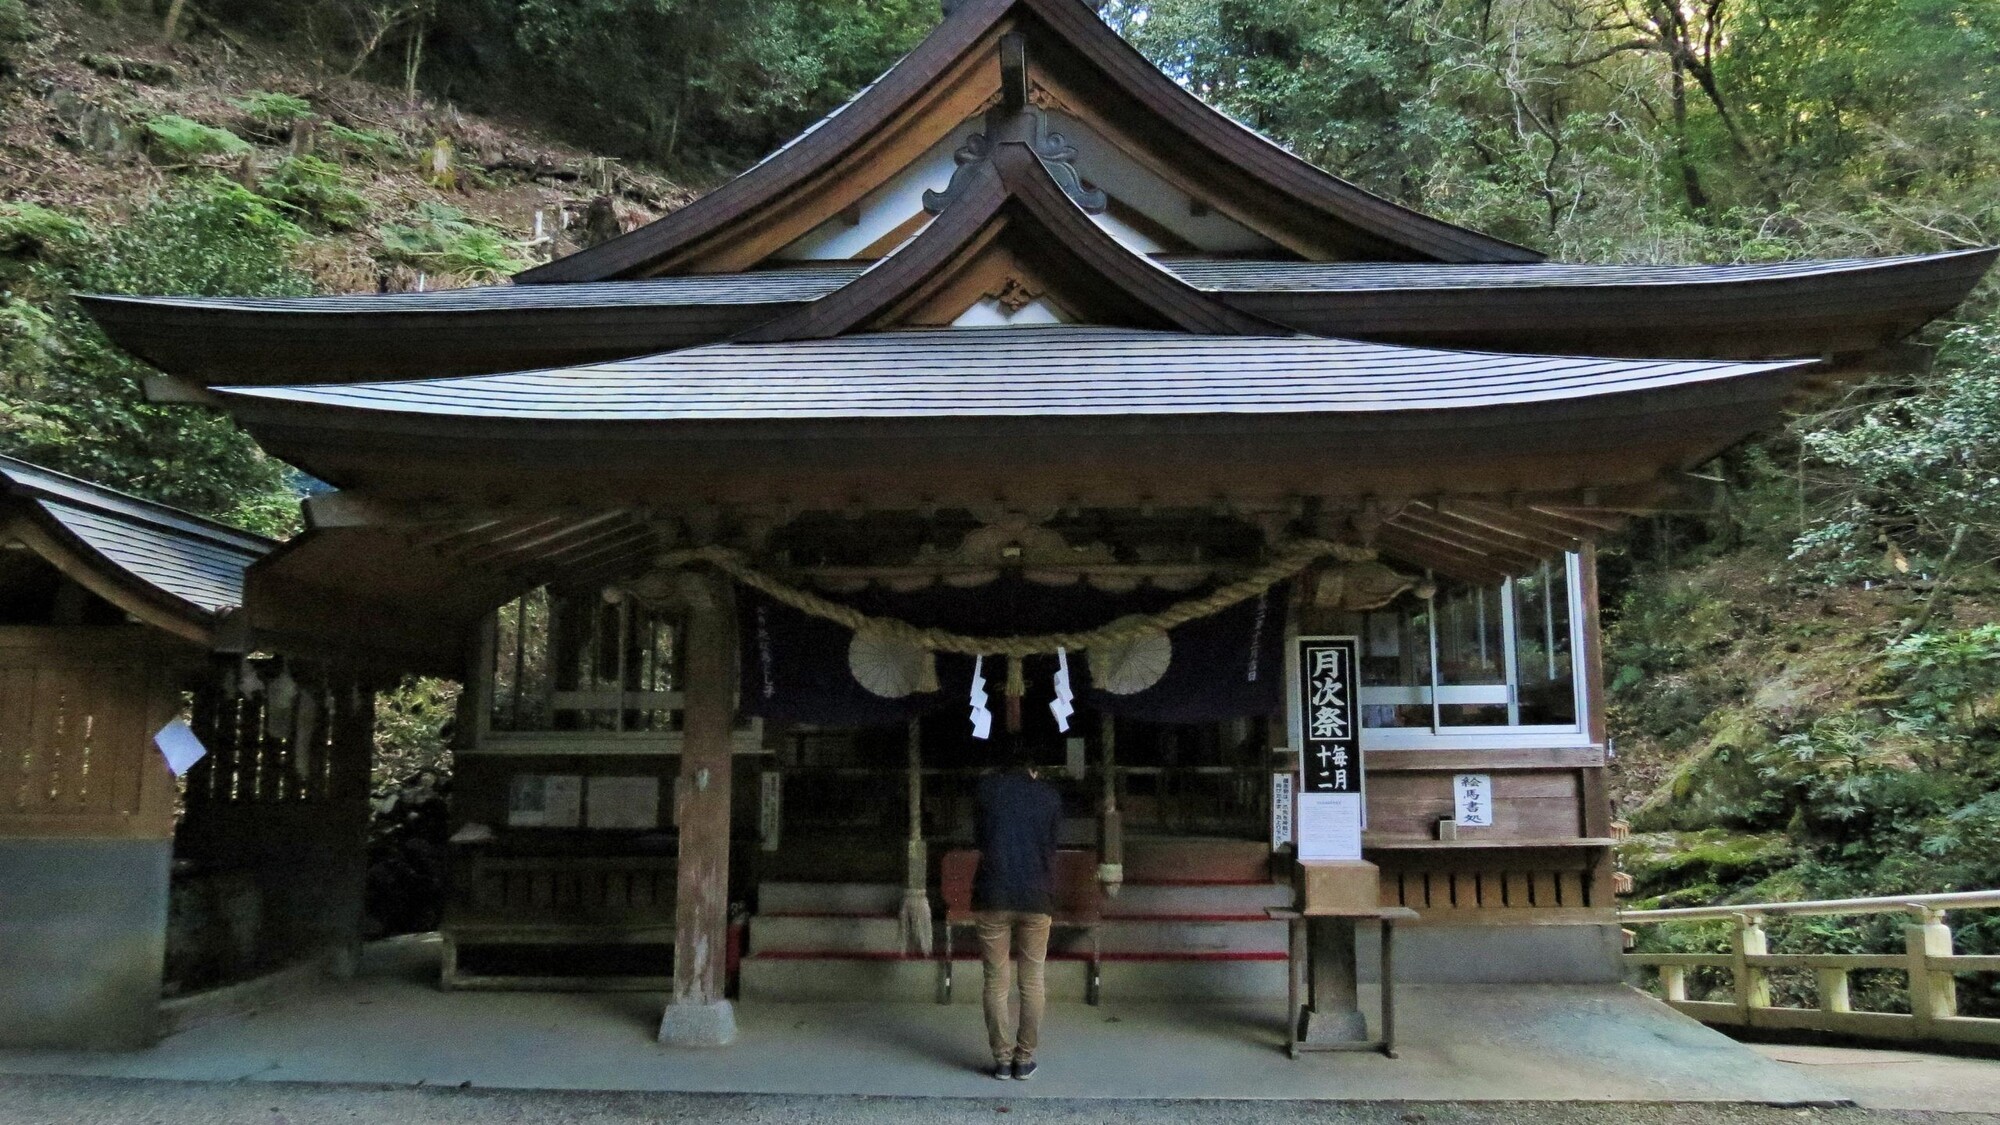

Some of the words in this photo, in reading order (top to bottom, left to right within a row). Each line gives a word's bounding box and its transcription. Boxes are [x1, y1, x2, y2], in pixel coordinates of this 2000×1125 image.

[1312, 650, 1347, 737] 月次祭
[1316, 744, 1333, 789] 十二
[1332, 744, 1348, 790] 毎月
[1461, 776, 1484, 824] 絵馬書処
